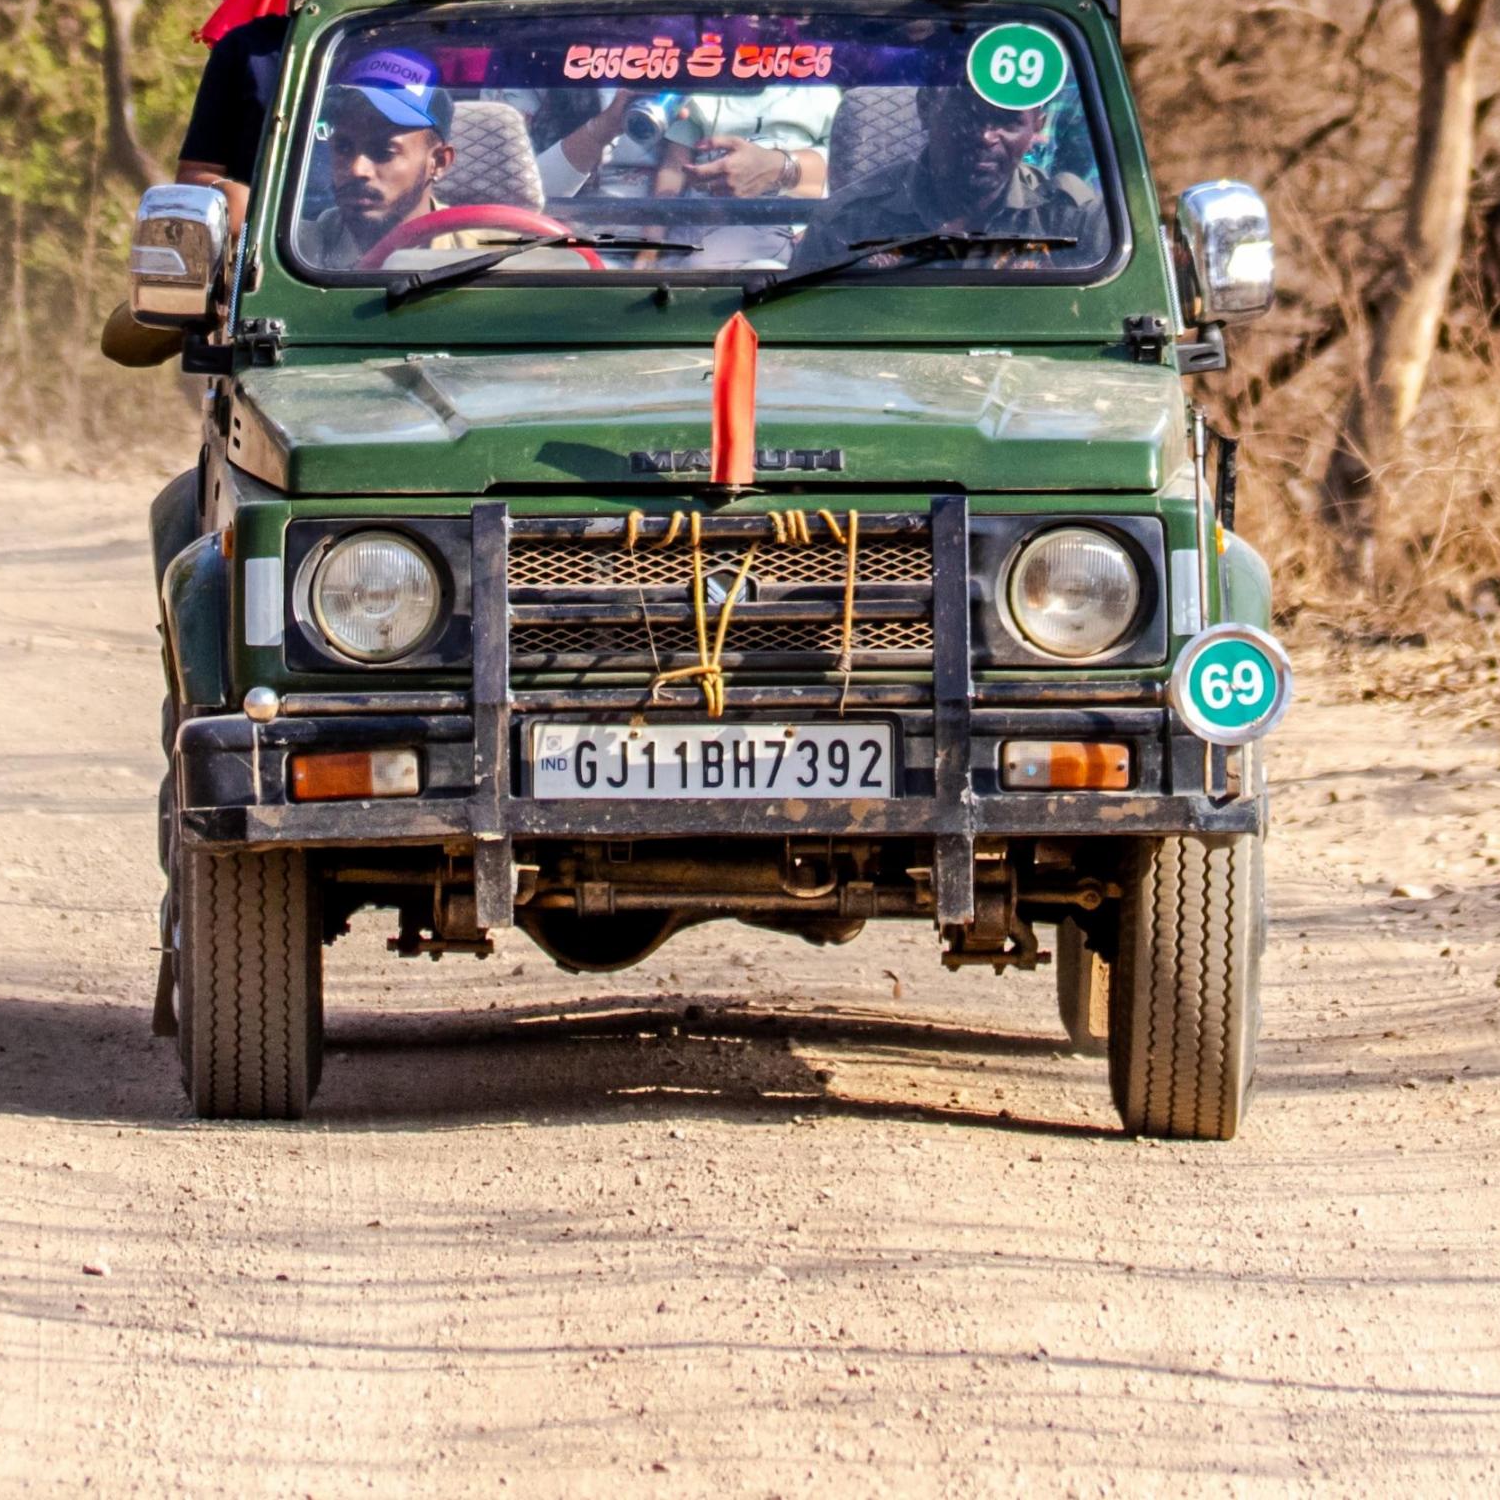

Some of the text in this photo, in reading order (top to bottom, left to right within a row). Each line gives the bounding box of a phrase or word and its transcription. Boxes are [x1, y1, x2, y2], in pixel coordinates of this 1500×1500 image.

[990, 45, 1044, 88] 69
[630, 449, 844, 472] MAUTI
[1201, 660, 1264, 709] 69
[541, 740, 882, 789] IND GJ11BH7392
